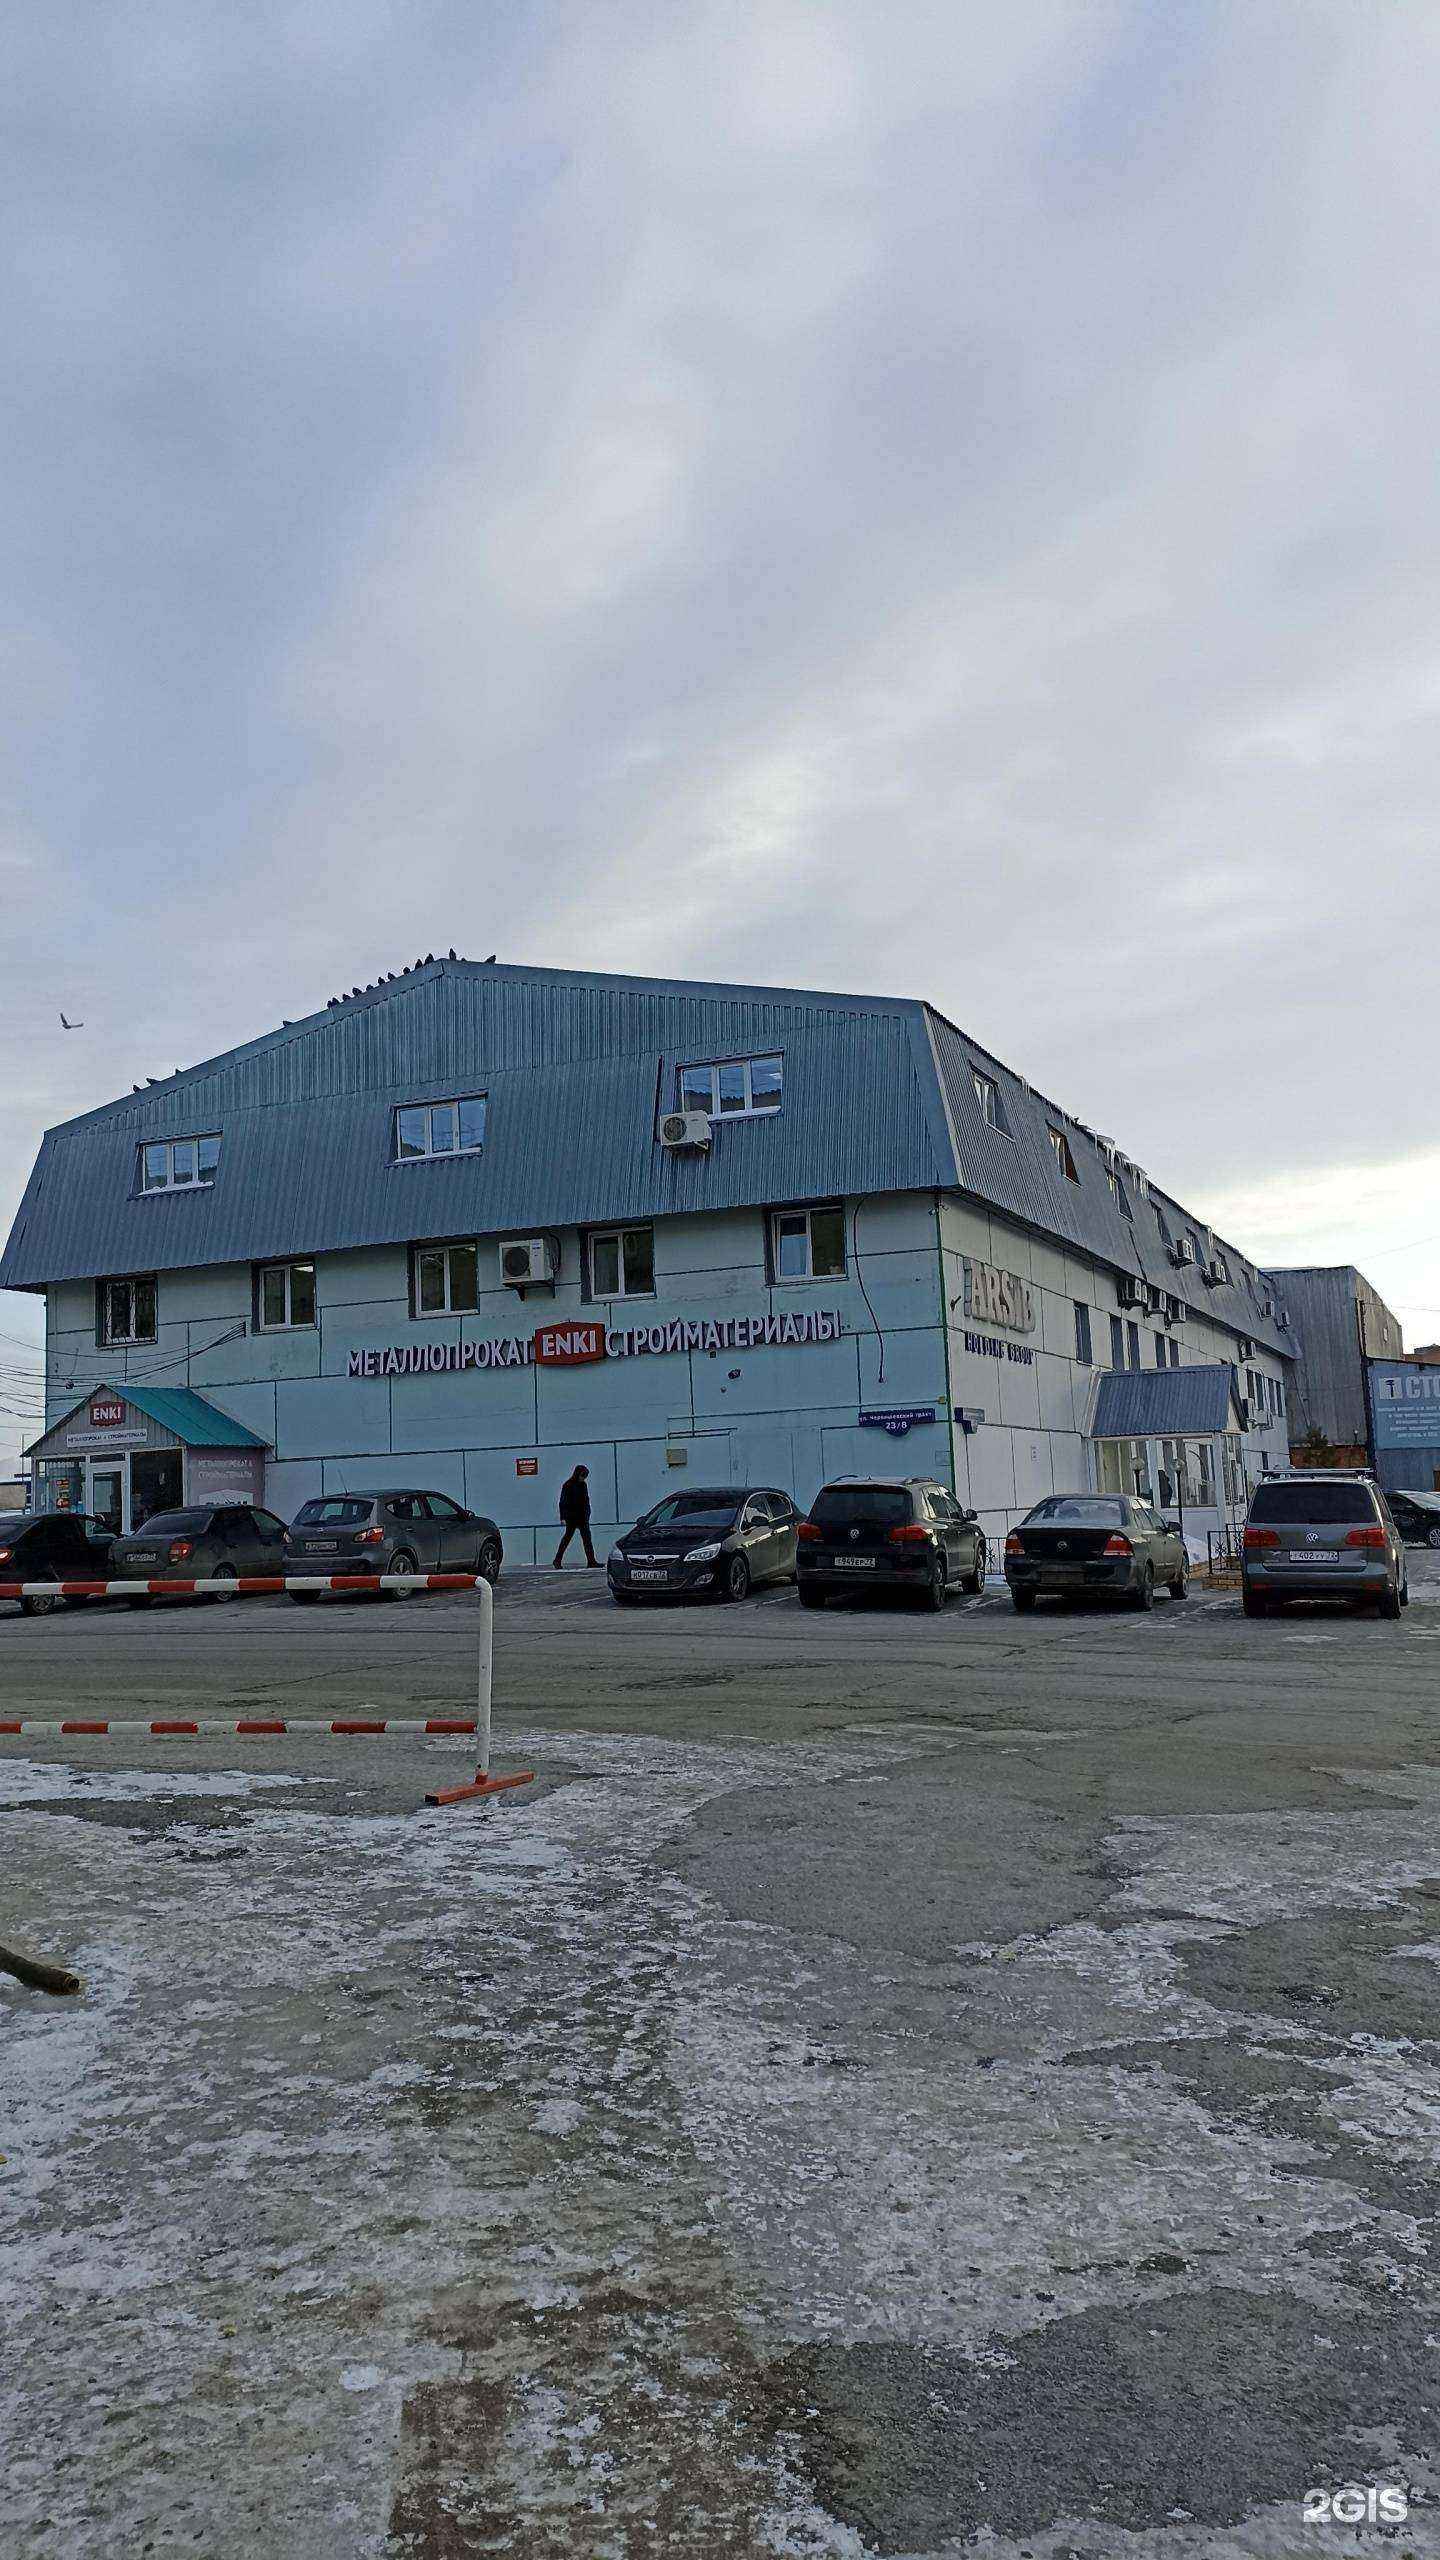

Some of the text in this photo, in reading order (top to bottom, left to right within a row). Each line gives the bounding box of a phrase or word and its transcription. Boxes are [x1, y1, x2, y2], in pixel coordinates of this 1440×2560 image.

[347, 1310, 841, 1377] МЕТАЛЛОПРОКАТ ENKI СТРОЙМАТЕРИАЛЫ
[93, 1406, 122, 1420] ENKI
[885, 1421, 908, 1430] 23/8
